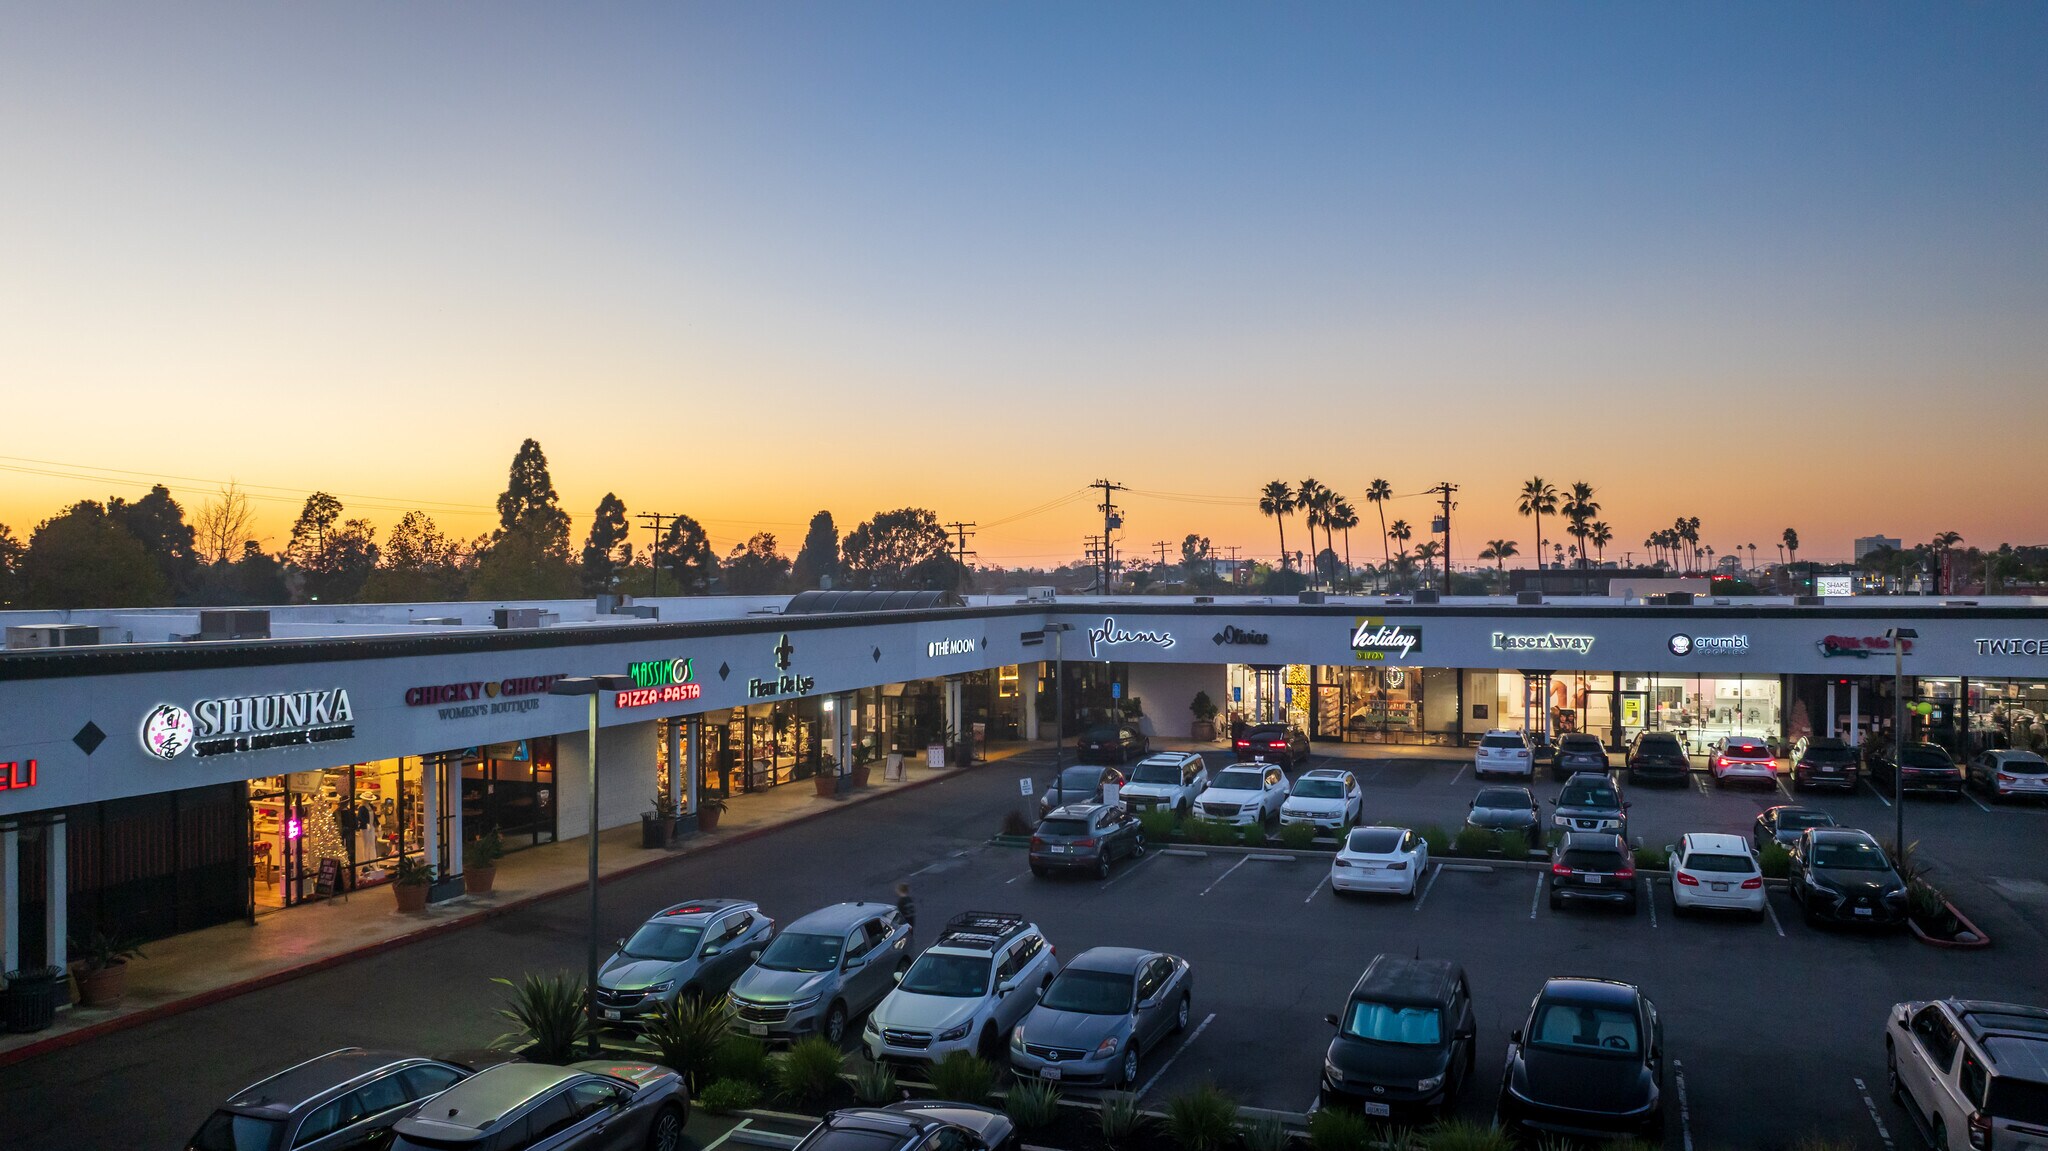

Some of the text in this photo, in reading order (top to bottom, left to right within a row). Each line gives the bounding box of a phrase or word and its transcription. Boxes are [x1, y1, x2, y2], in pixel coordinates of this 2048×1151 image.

[934, 637, 975, 656] THÉ MOON
[1088, 617, 1175, 657] plums
[1352, 619, 1416, 659] holiday
[1492, 632, 1595, 654] LaserAway
[1694, 634, 1749, 648] crumbl
[405, 674, 568, 707] CHICKY CHICK
[779, 674, 795, 694] De
[193, 689, 355, 737] SHUNKA
[438, 698, 539, 720] WOMEN'S BOUTIQUE
